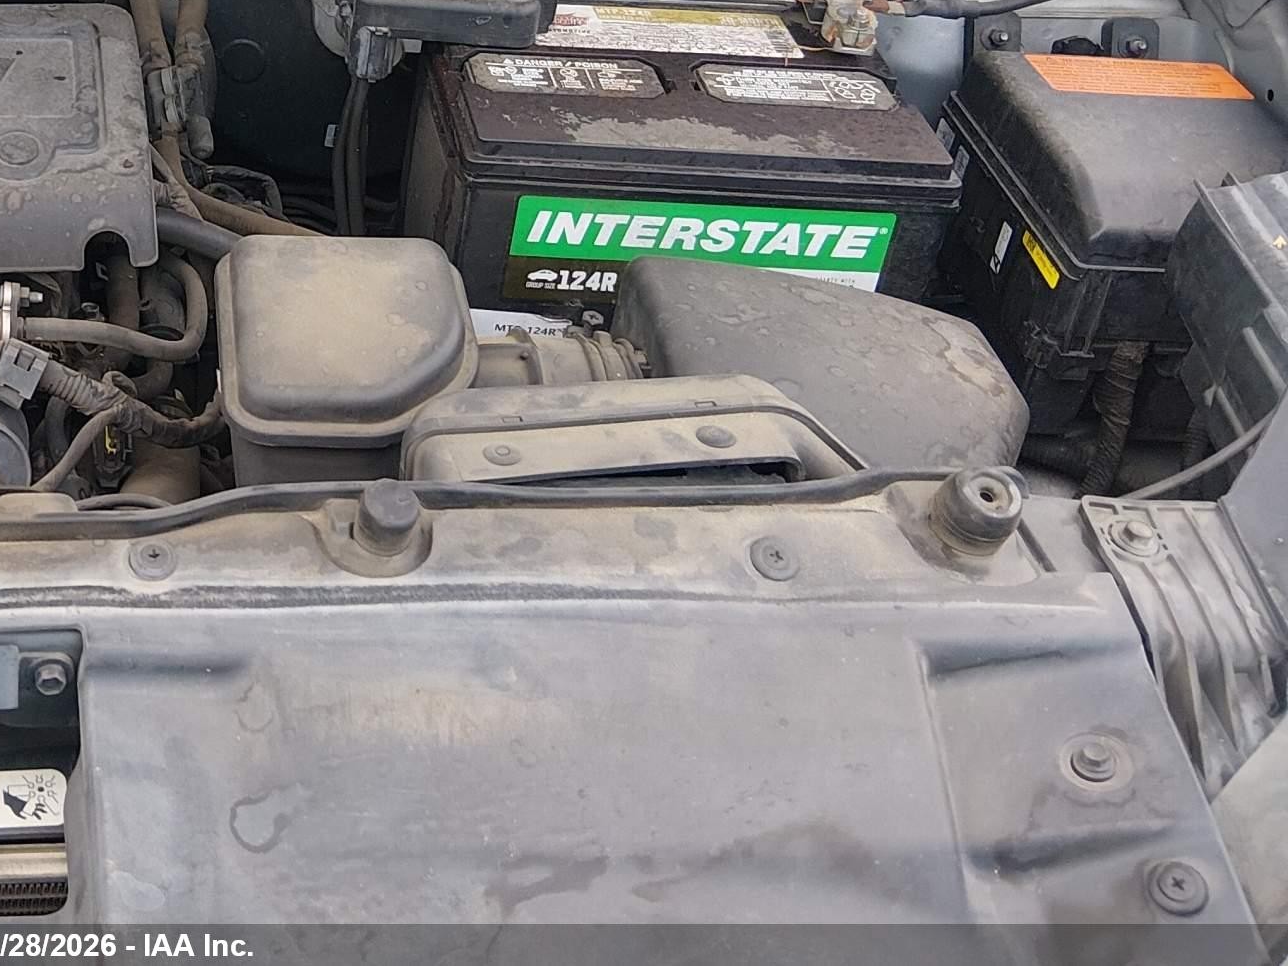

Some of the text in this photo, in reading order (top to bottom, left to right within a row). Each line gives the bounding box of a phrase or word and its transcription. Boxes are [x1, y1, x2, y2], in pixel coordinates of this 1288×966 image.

[515, 58, 562, 68] DANGER
[575, 61, 618, 70] POISON
[527, 210, 878, 259] INTERSTATE
[557, 269, 618, 292] 124R
